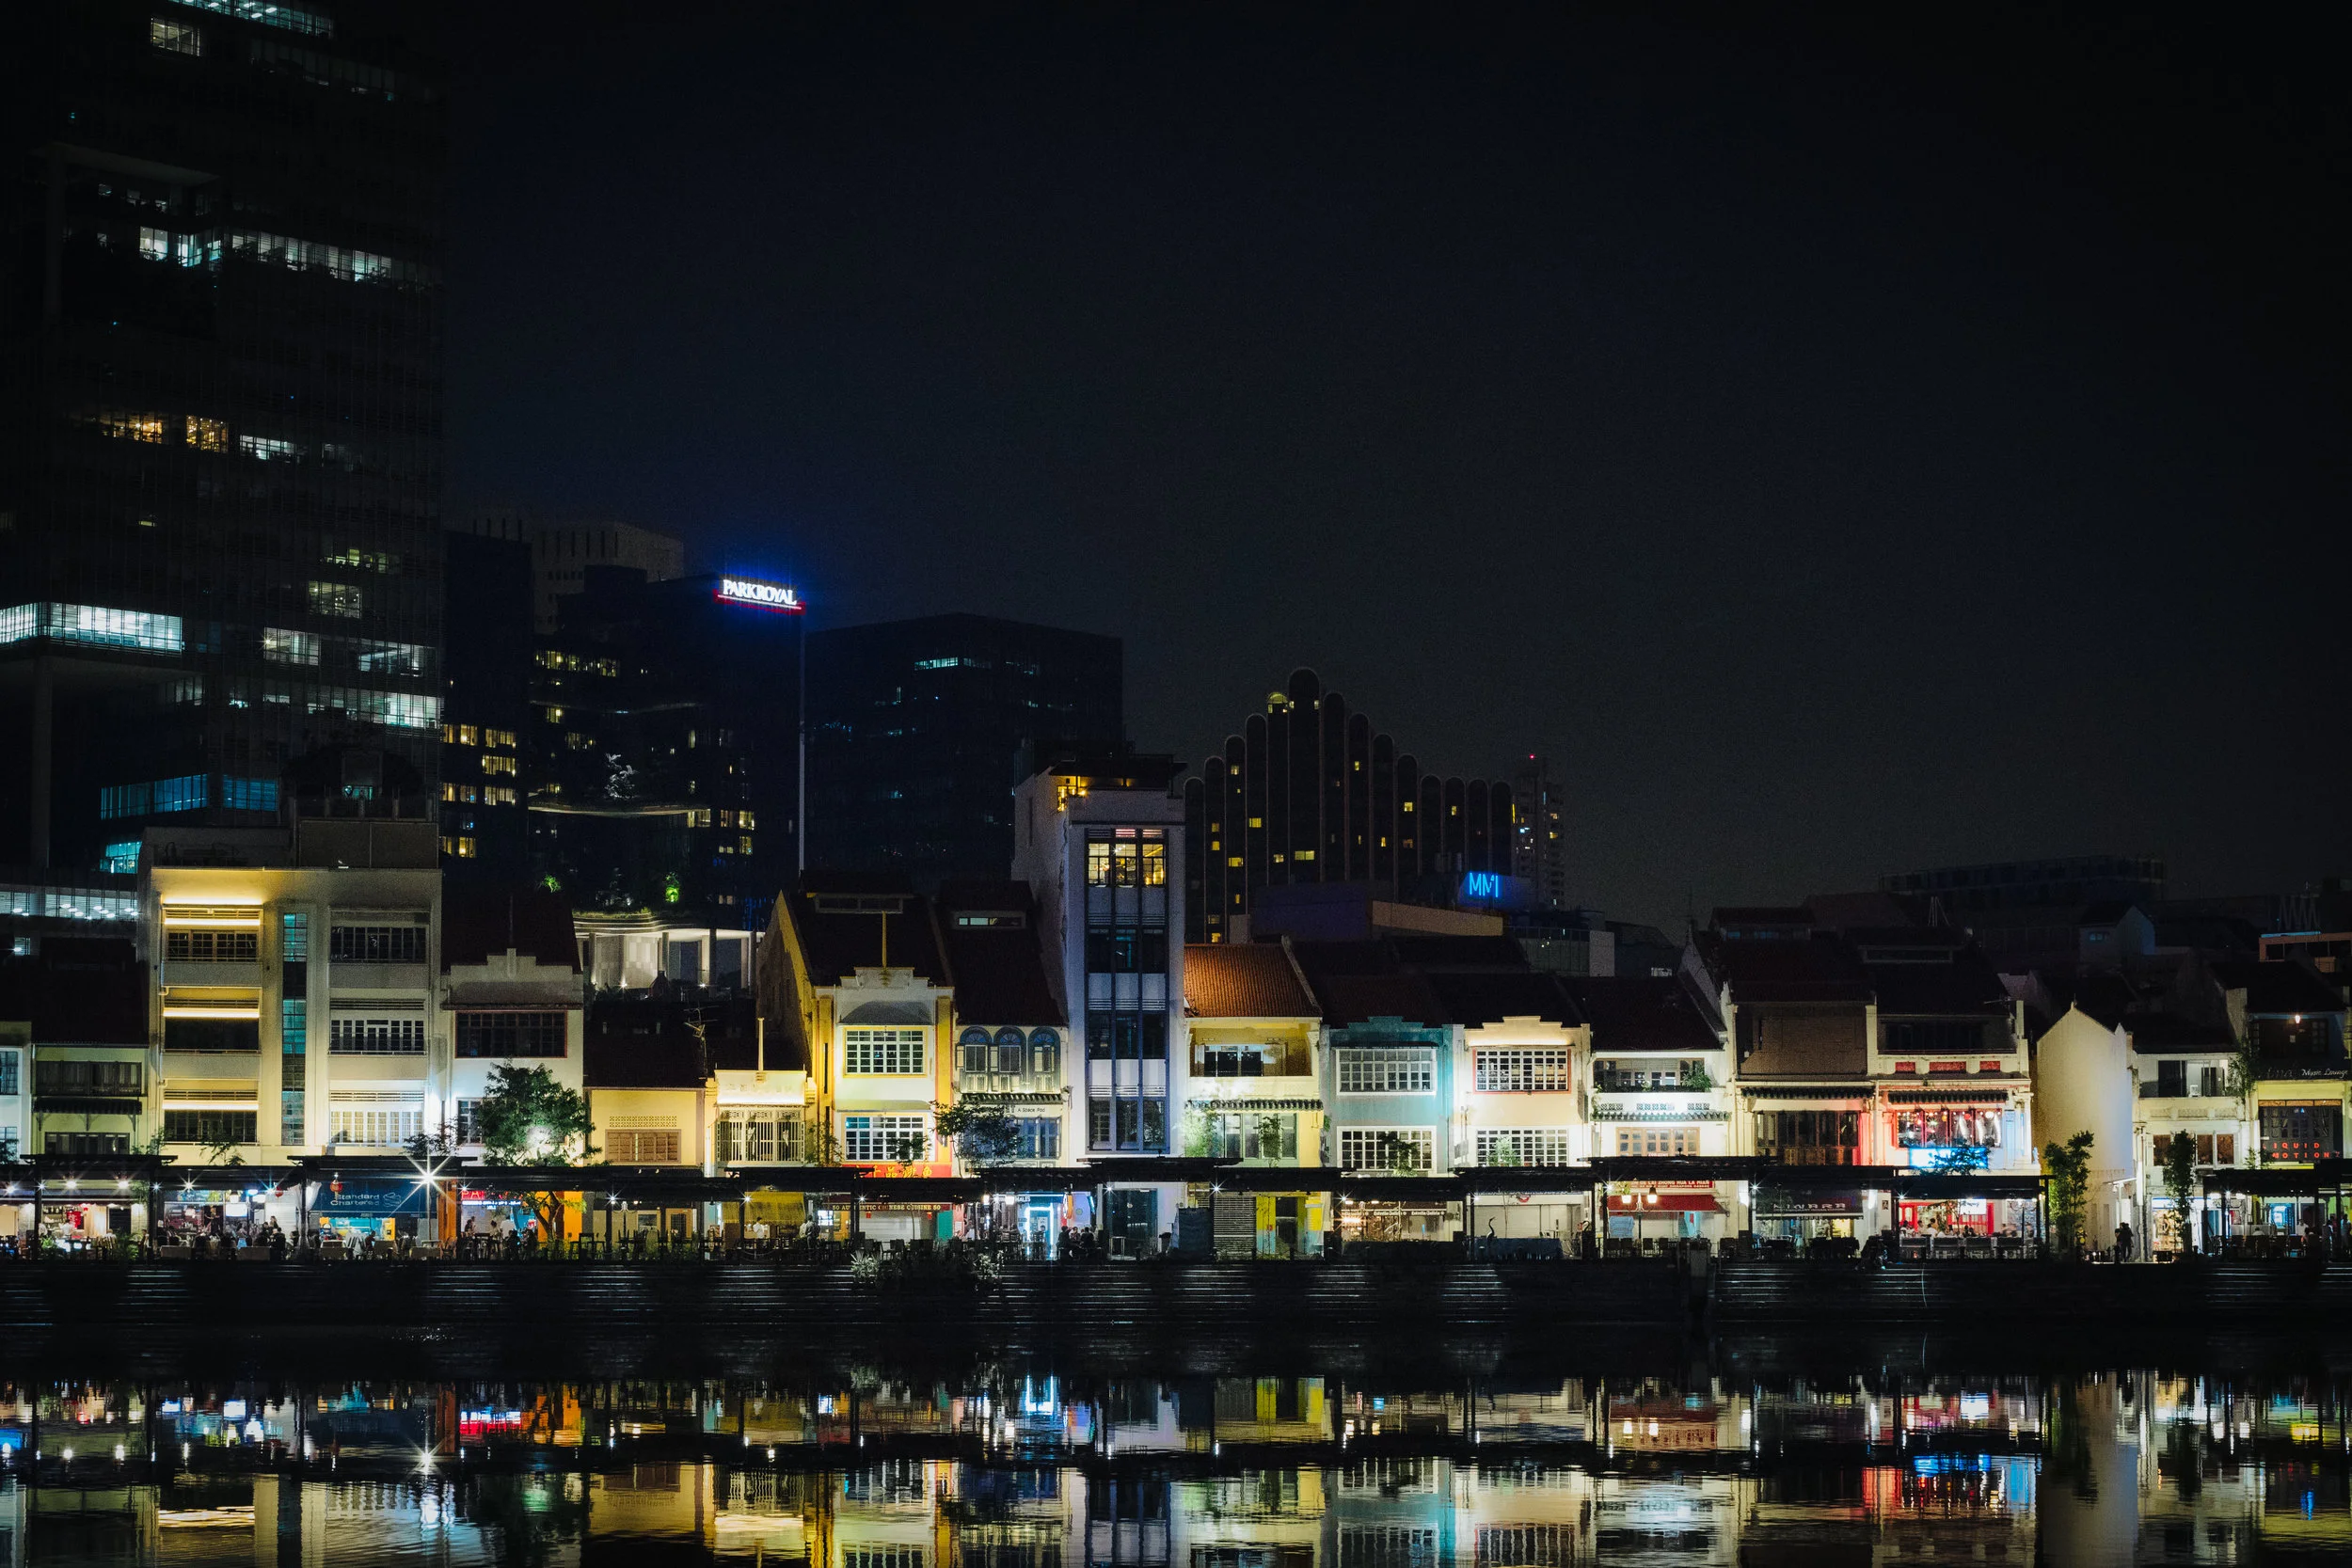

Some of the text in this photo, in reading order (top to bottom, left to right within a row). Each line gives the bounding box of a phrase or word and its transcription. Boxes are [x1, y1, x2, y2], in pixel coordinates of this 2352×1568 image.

[723, 578, 798, 606] PARKROYAL
[2301, 1068, 2322, 1077] Music
[2324, 1068, 2348, 1079] Lounge
